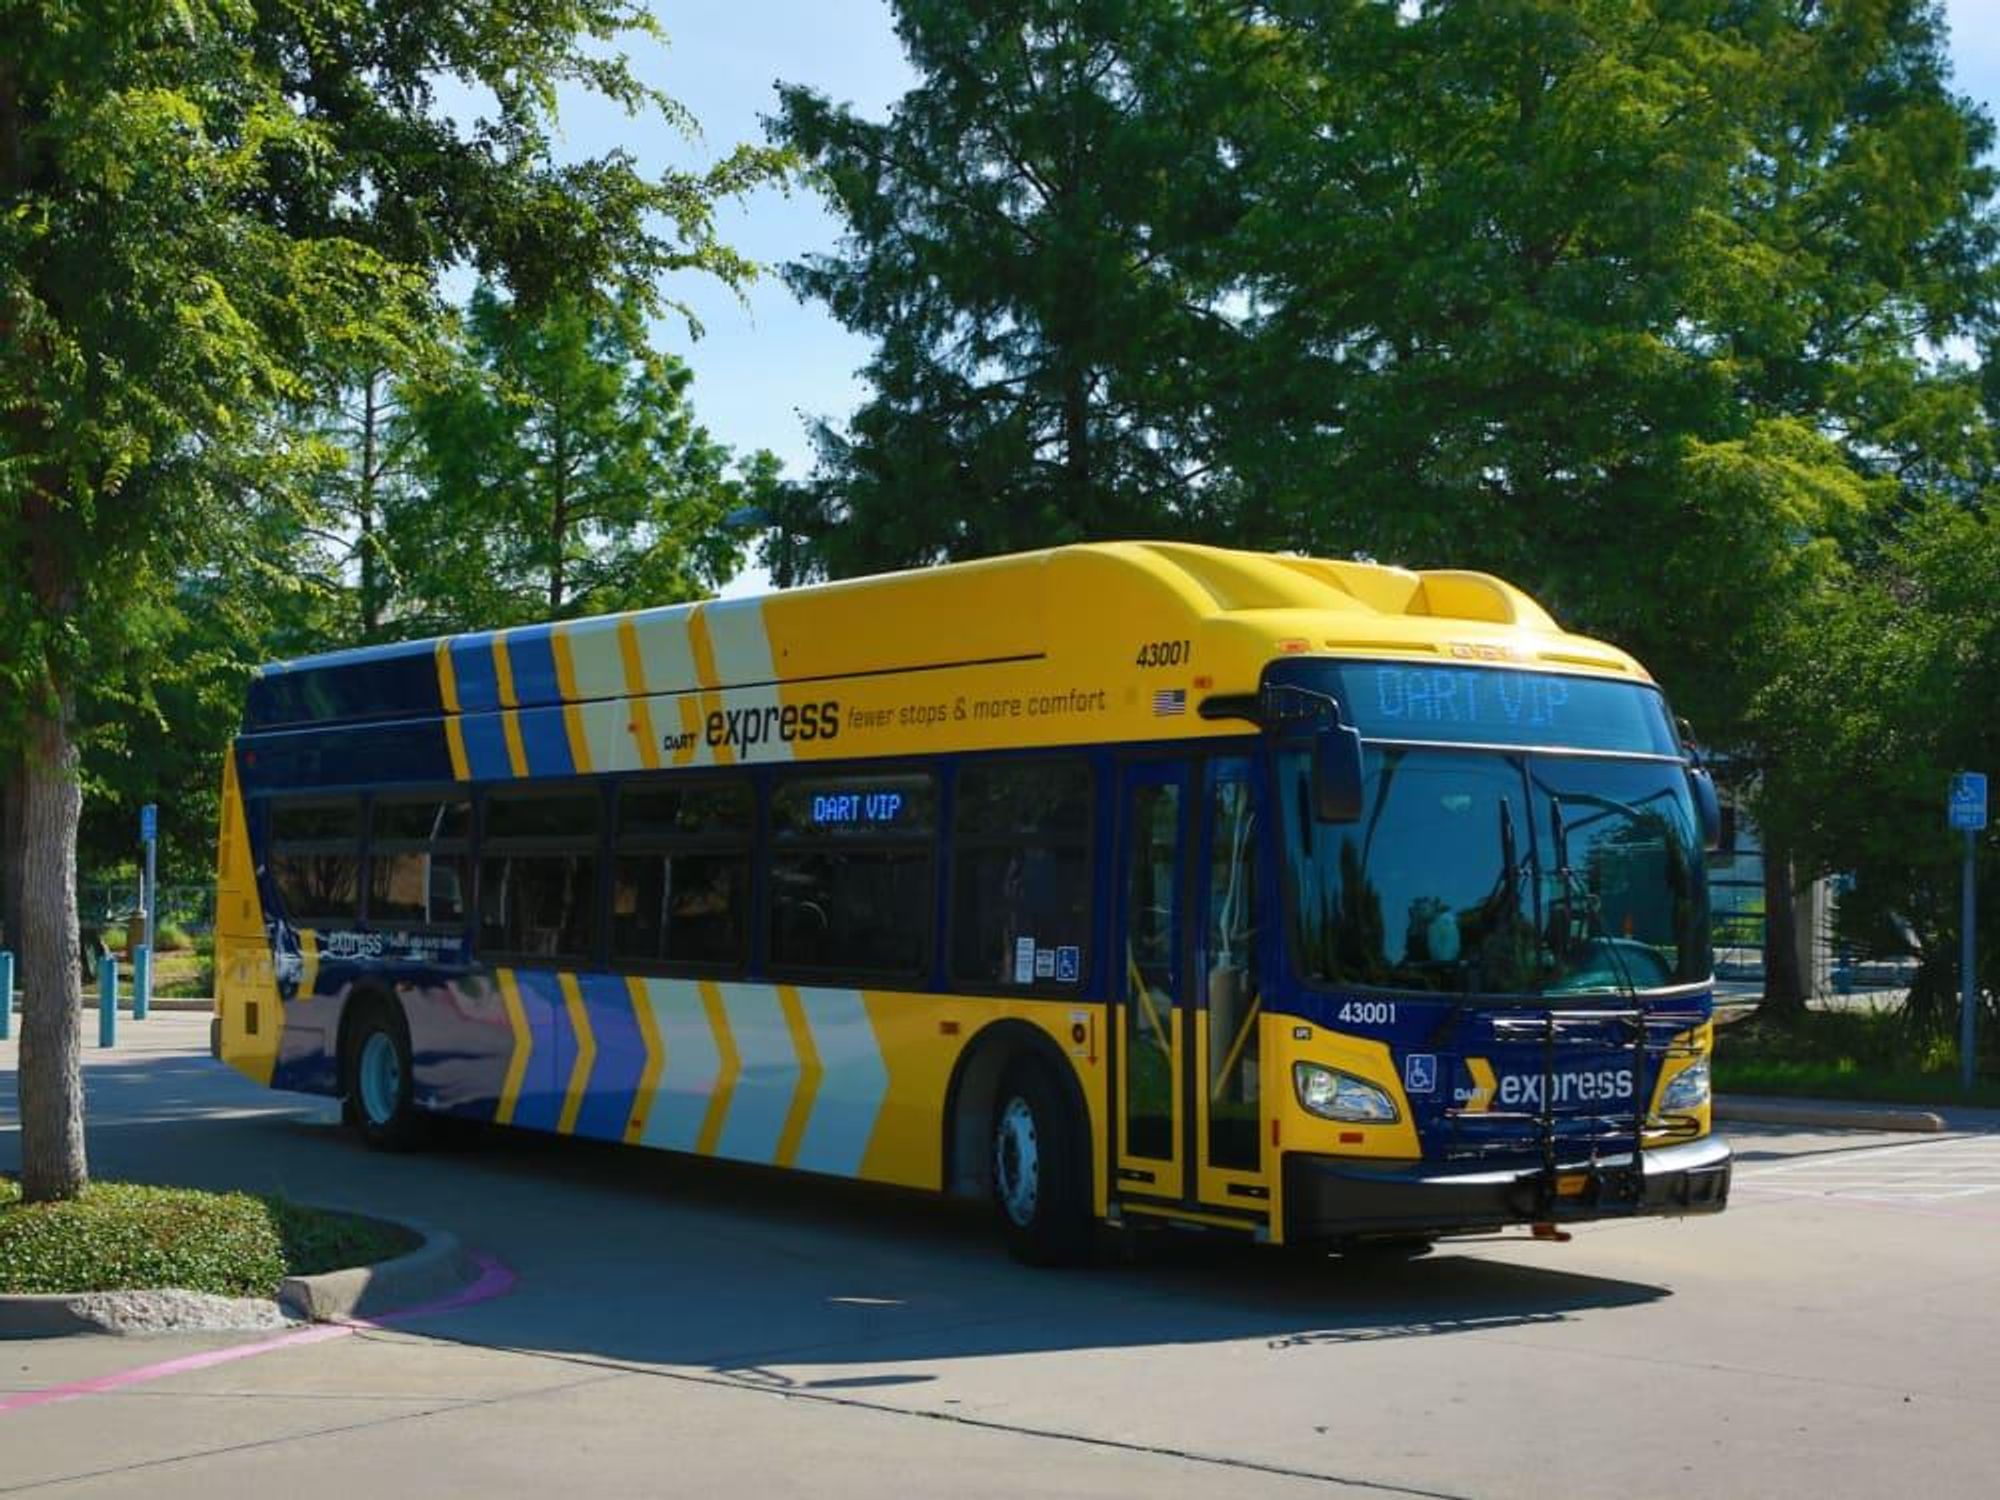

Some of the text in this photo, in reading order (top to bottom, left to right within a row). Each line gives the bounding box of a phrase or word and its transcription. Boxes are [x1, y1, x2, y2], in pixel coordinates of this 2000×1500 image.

[1136, 640, 1190, 668] 43001
[1376, 667, 1568, 727] DART VIP
[664, 688, 1106, 760] DART express fewer stops & more comfort
[813, 793, 901, 821] DART VIP
[1338, 1002, 1396, 1024] 43001
